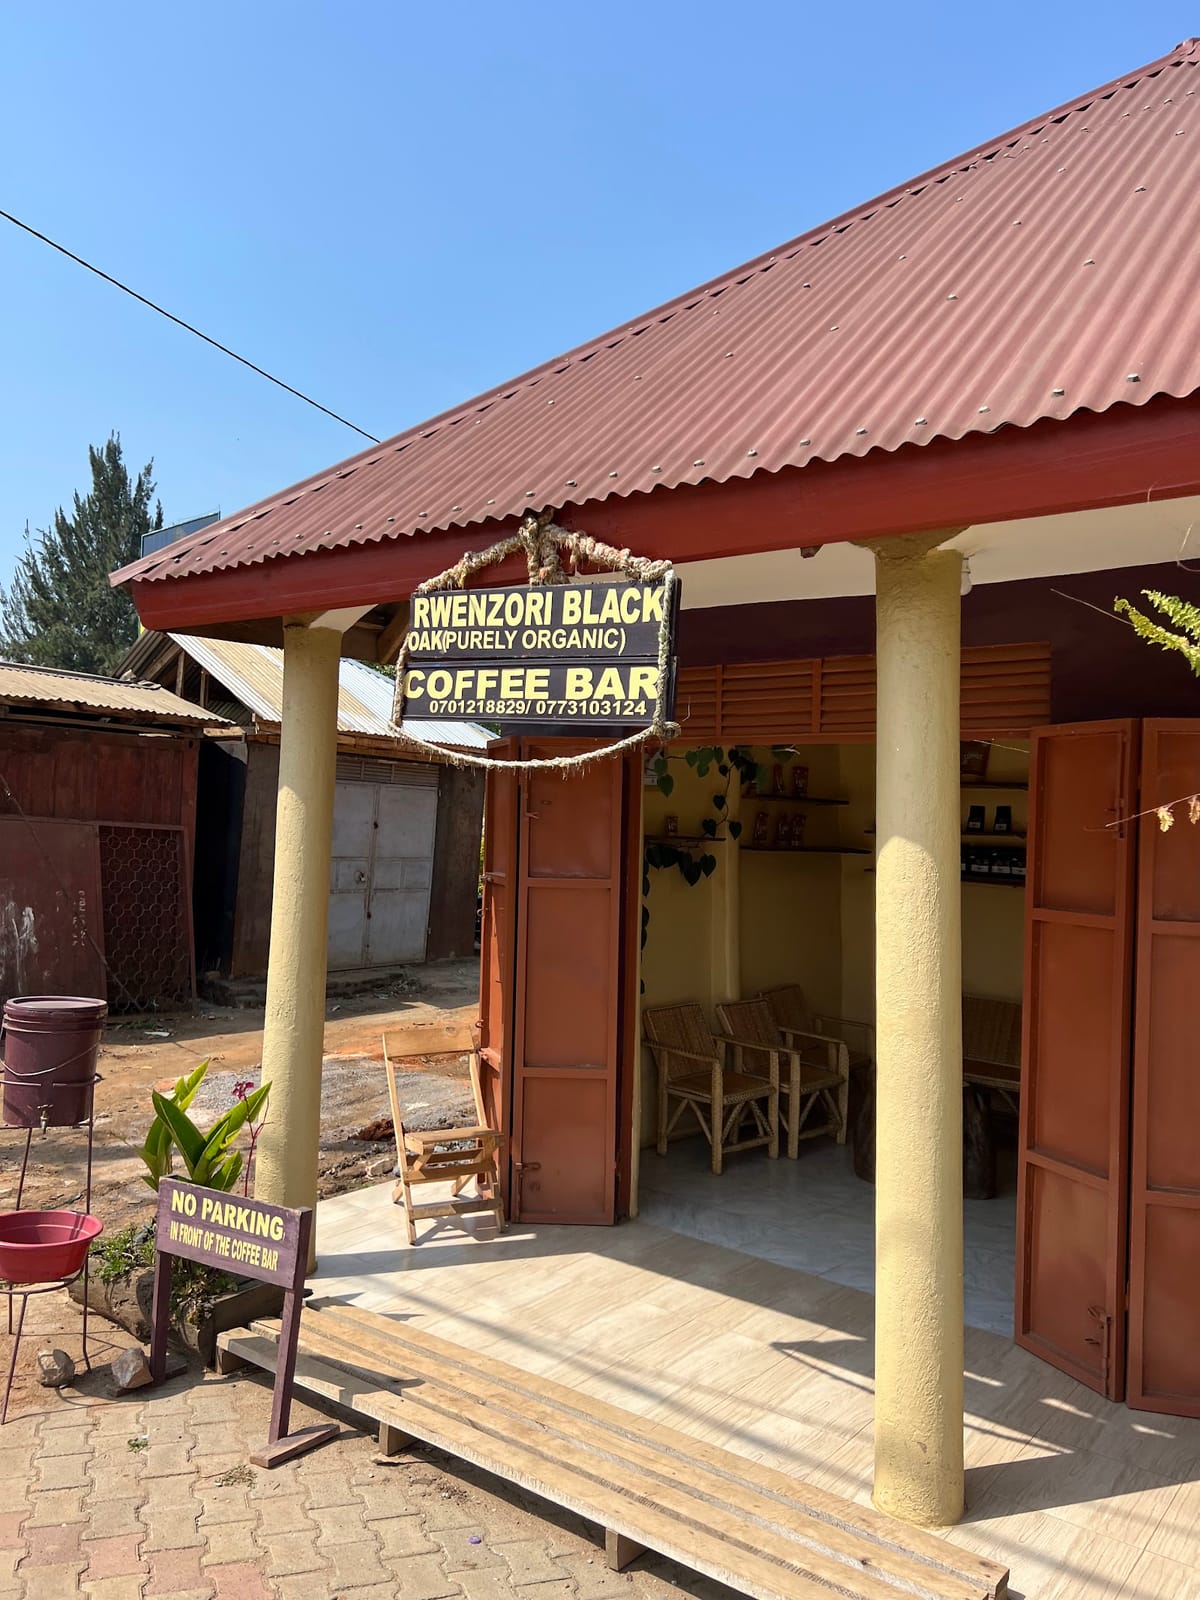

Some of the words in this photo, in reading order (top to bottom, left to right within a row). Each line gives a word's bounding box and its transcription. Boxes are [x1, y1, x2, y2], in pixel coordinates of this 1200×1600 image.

[413, 591, 553, 628] RWENZORI
[562, 586, 665, 625] BLACK
[522, 628, 626, 655] ORGANIC)
[404, 668, 550, 699] COFFEE
[565, 667, 659, 700] BAR
[536, 700, 646, 716] 0773103124
[171, 1190, 197, 1217] NO
[201, 1198, 284, 1240] PARKING
[170, 1221, 179, 1240] IN
[179, 1223, 203, 1249] FRONT
[204, 1231, 214, 1251] OF
[215, 1233, 231, 1257] THE
[231, 1238, 261, 1266] COFFEE
[261, 1247, 279, 1271] BAR
